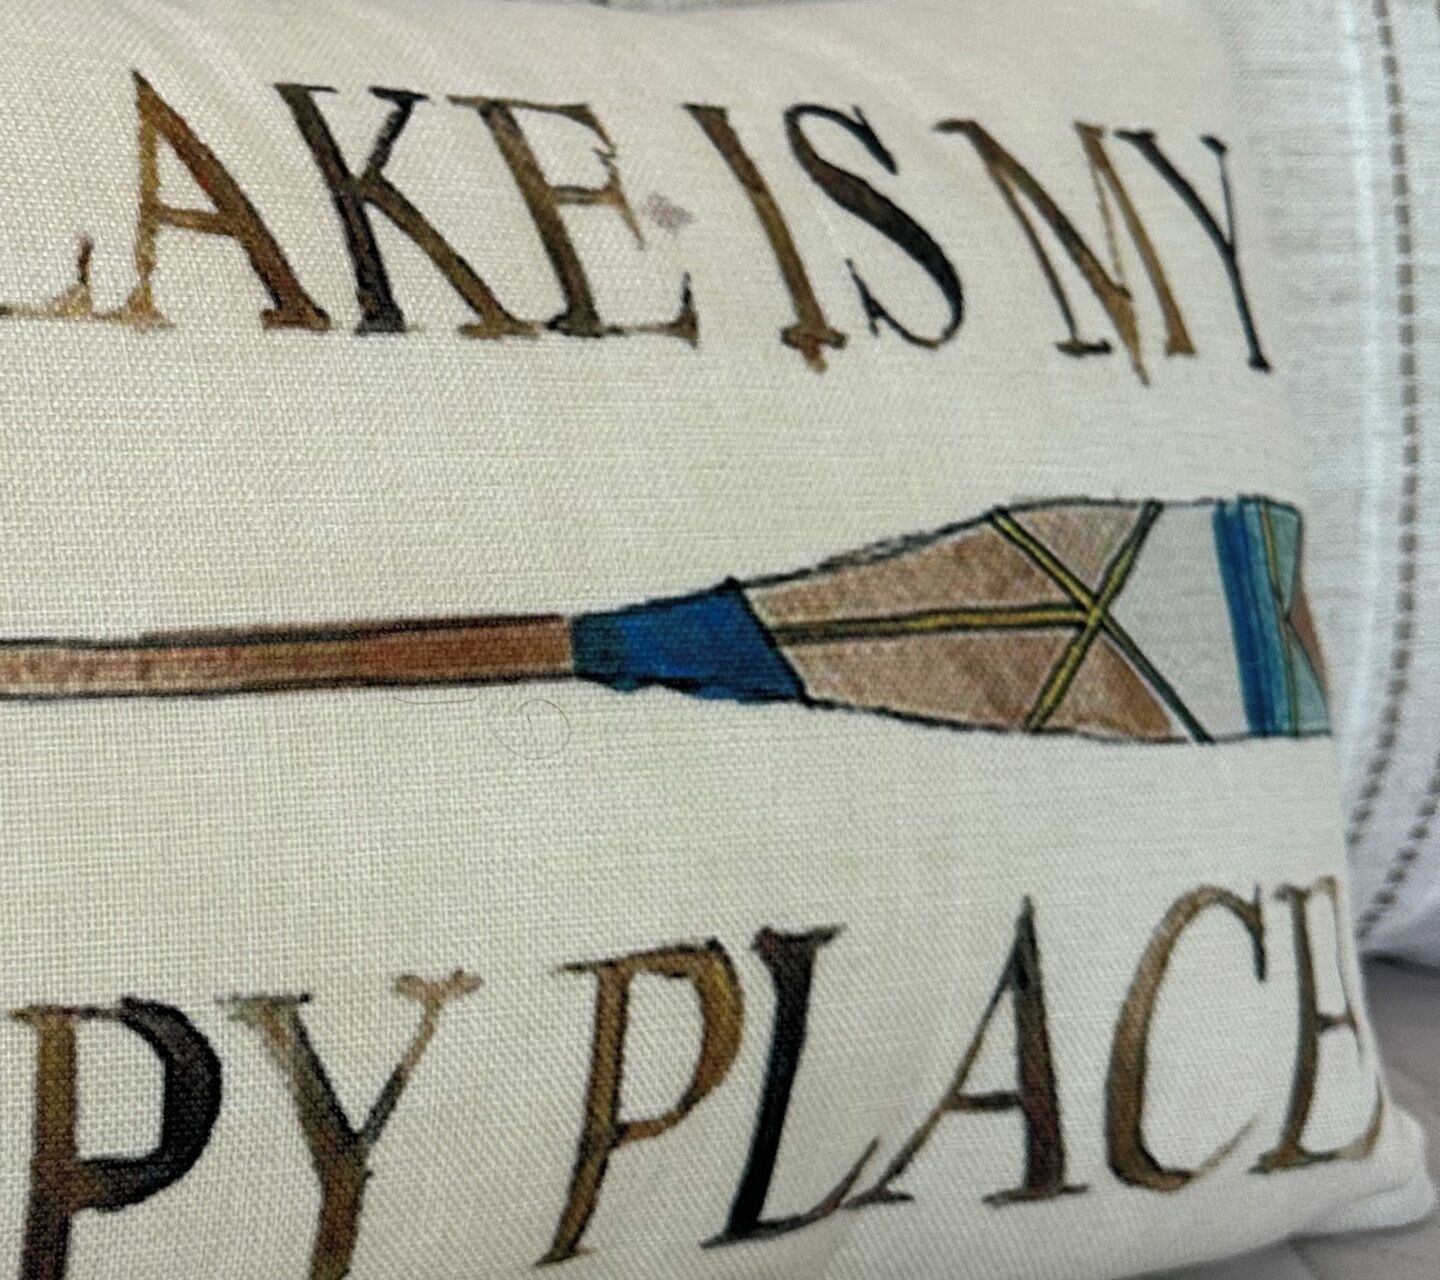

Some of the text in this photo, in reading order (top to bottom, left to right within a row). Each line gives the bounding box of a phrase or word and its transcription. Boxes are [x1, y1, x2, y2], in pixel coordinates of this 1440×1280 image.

[681, 101, 964, 372] IS
[931, 118, 1274, 385] MY
[533, 874, 1386, 1266] PLACE
